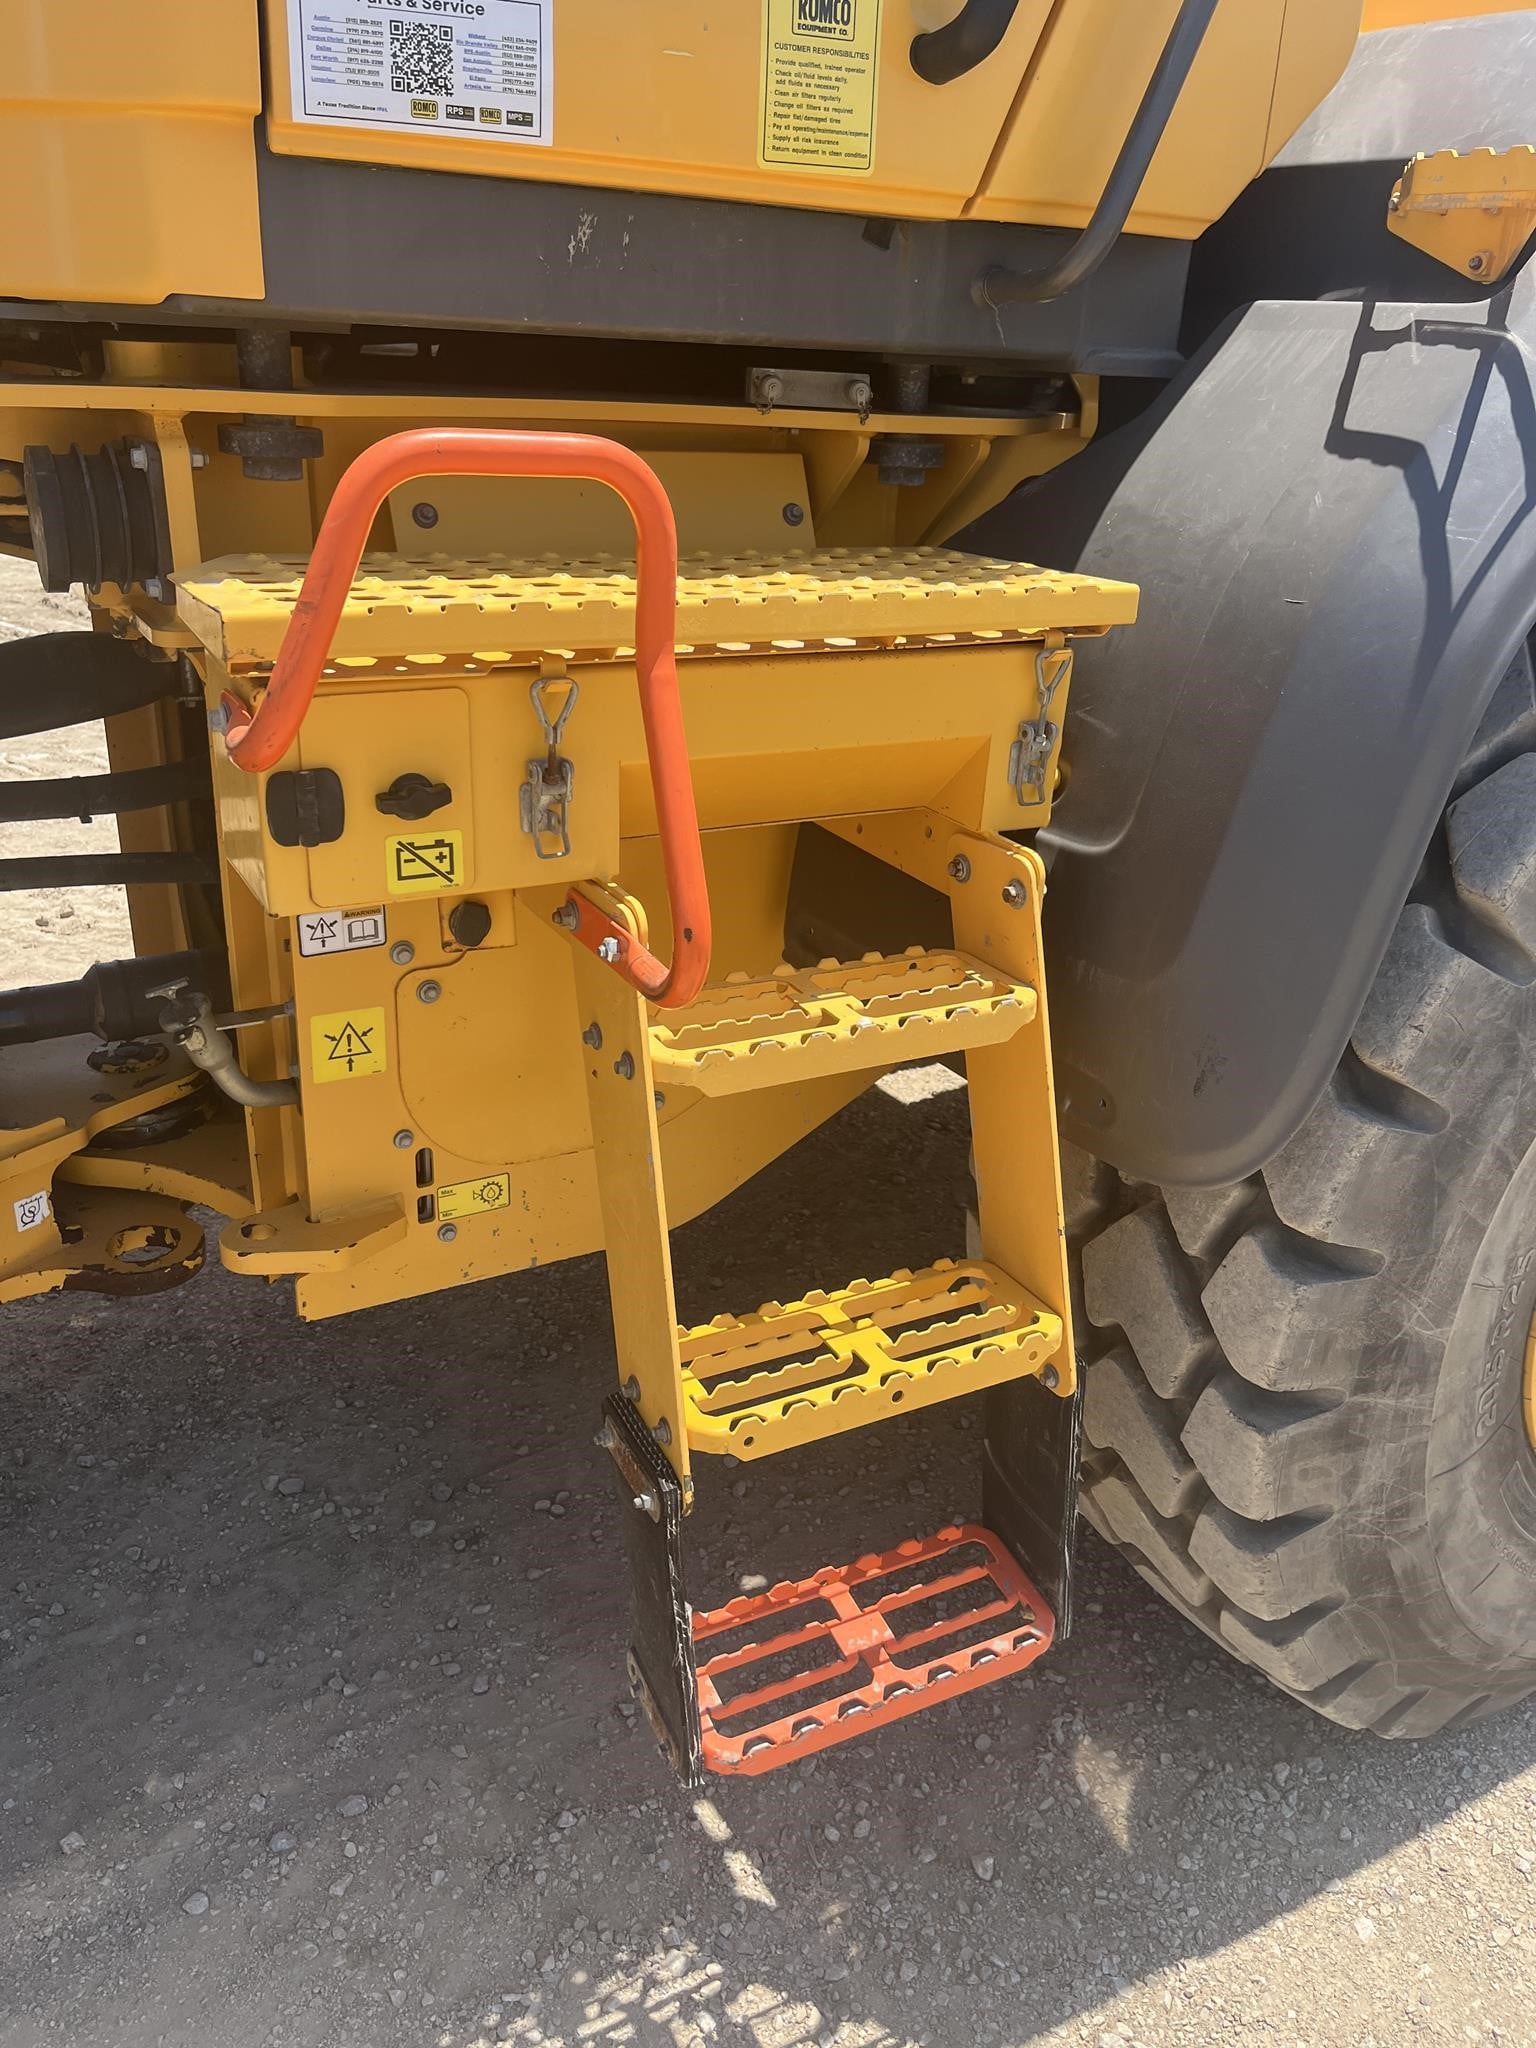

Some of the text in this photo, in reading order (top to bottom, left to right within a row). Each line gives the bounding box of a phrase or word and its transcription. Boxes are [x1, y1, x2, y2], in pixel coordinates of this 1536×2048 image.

[422, 0, 484, 15] Service
[799, 0, 851, 25] ROMCO
[798, 23, 848, 36] EQUIPMENT CO.
[775, 43, 869, 60] CUSTOMER RESPONSIBILITIES
[776, 58, 796, 66] Provide
[799, 61, 822, 70] qualified,
[814, 83, 840, 92] necessary
[819, 95, 841, 103] regularly
[413, 101, 436, 113] ROMCO
[774, 101, 794, 109] Change
[447, 106, 463, 115] RPS
[481, 110, 500, 119] ROMCO
[508, 113, 522, 121] MPS
[793, 114, 827, 123] flat/damaged
[773, 134, 791, 142] Supply
[351, 908, 380, 917] WARNING
